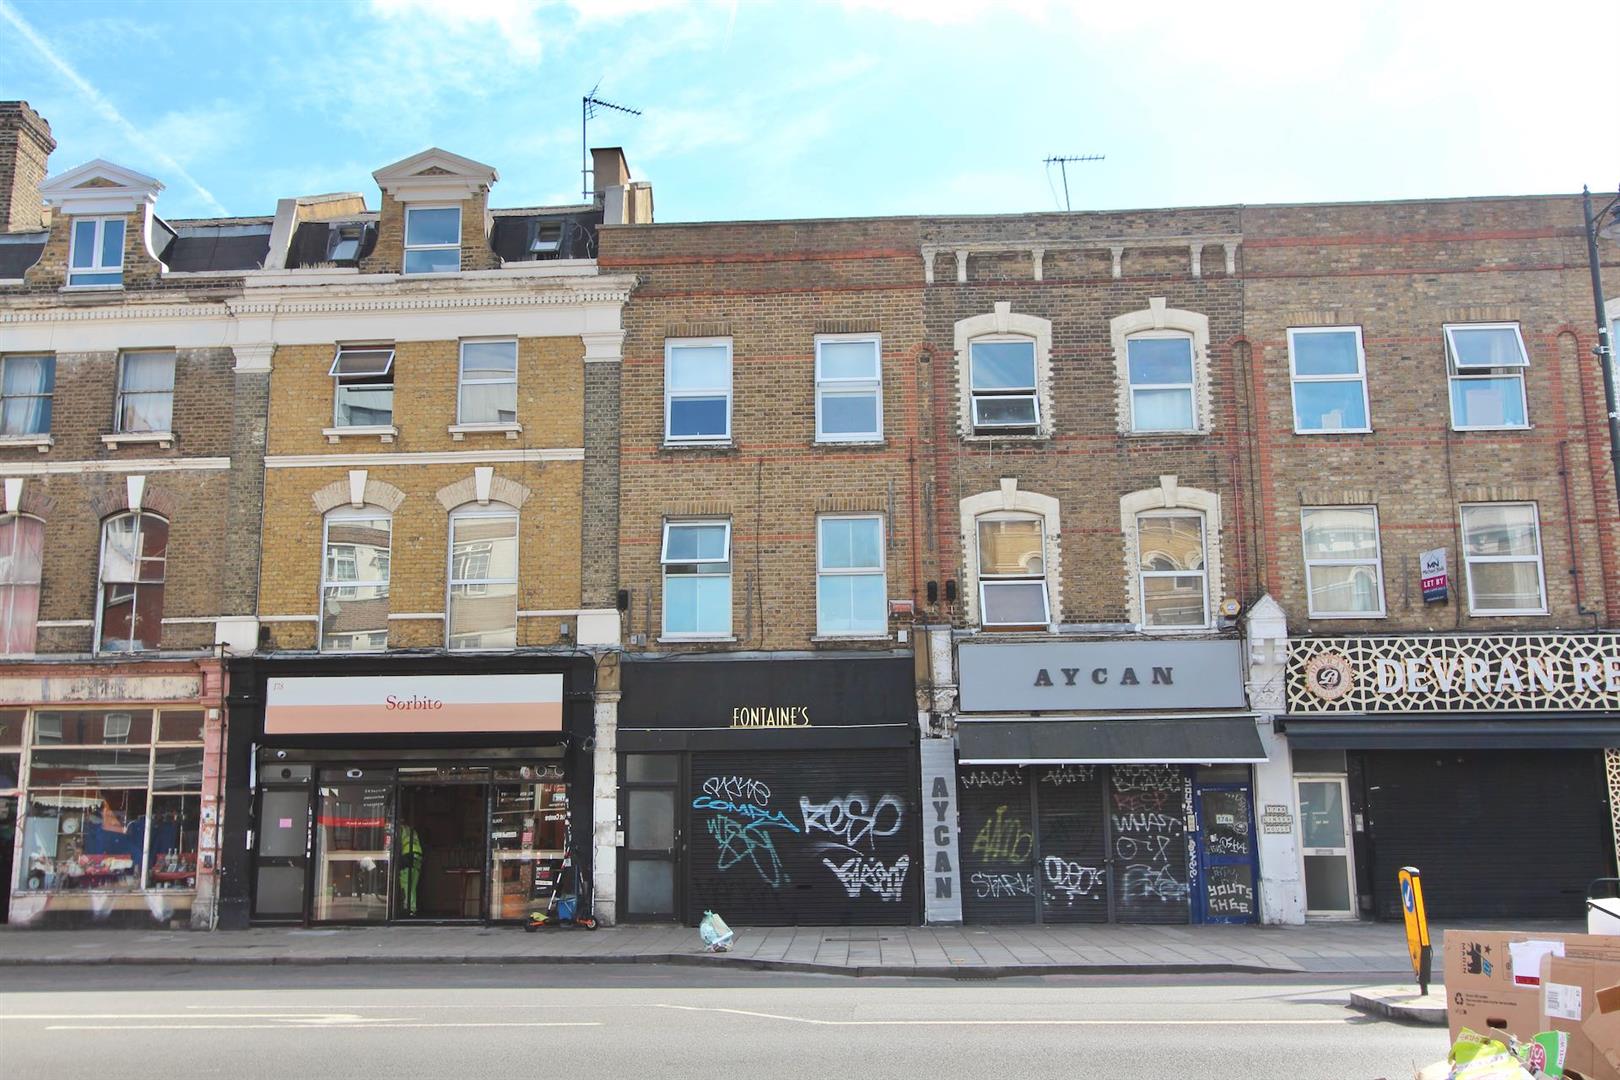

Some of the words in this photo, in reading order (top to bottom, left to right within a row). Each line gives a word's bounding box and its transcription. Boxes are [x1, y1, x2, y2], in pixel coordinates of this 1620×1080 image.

[1423, 579, 1434, 588] LET
[1435, 577, 1444, 586] BY
[1033, 666, 1175, 687] AYCAN
[1375, 656, 1556, 694] DEVRAN
[385, 694, 443, 710] Sorbito
[733, 706, 809, 727] FONTAINE'S
[931, 776, 953, 899] AYCAN
